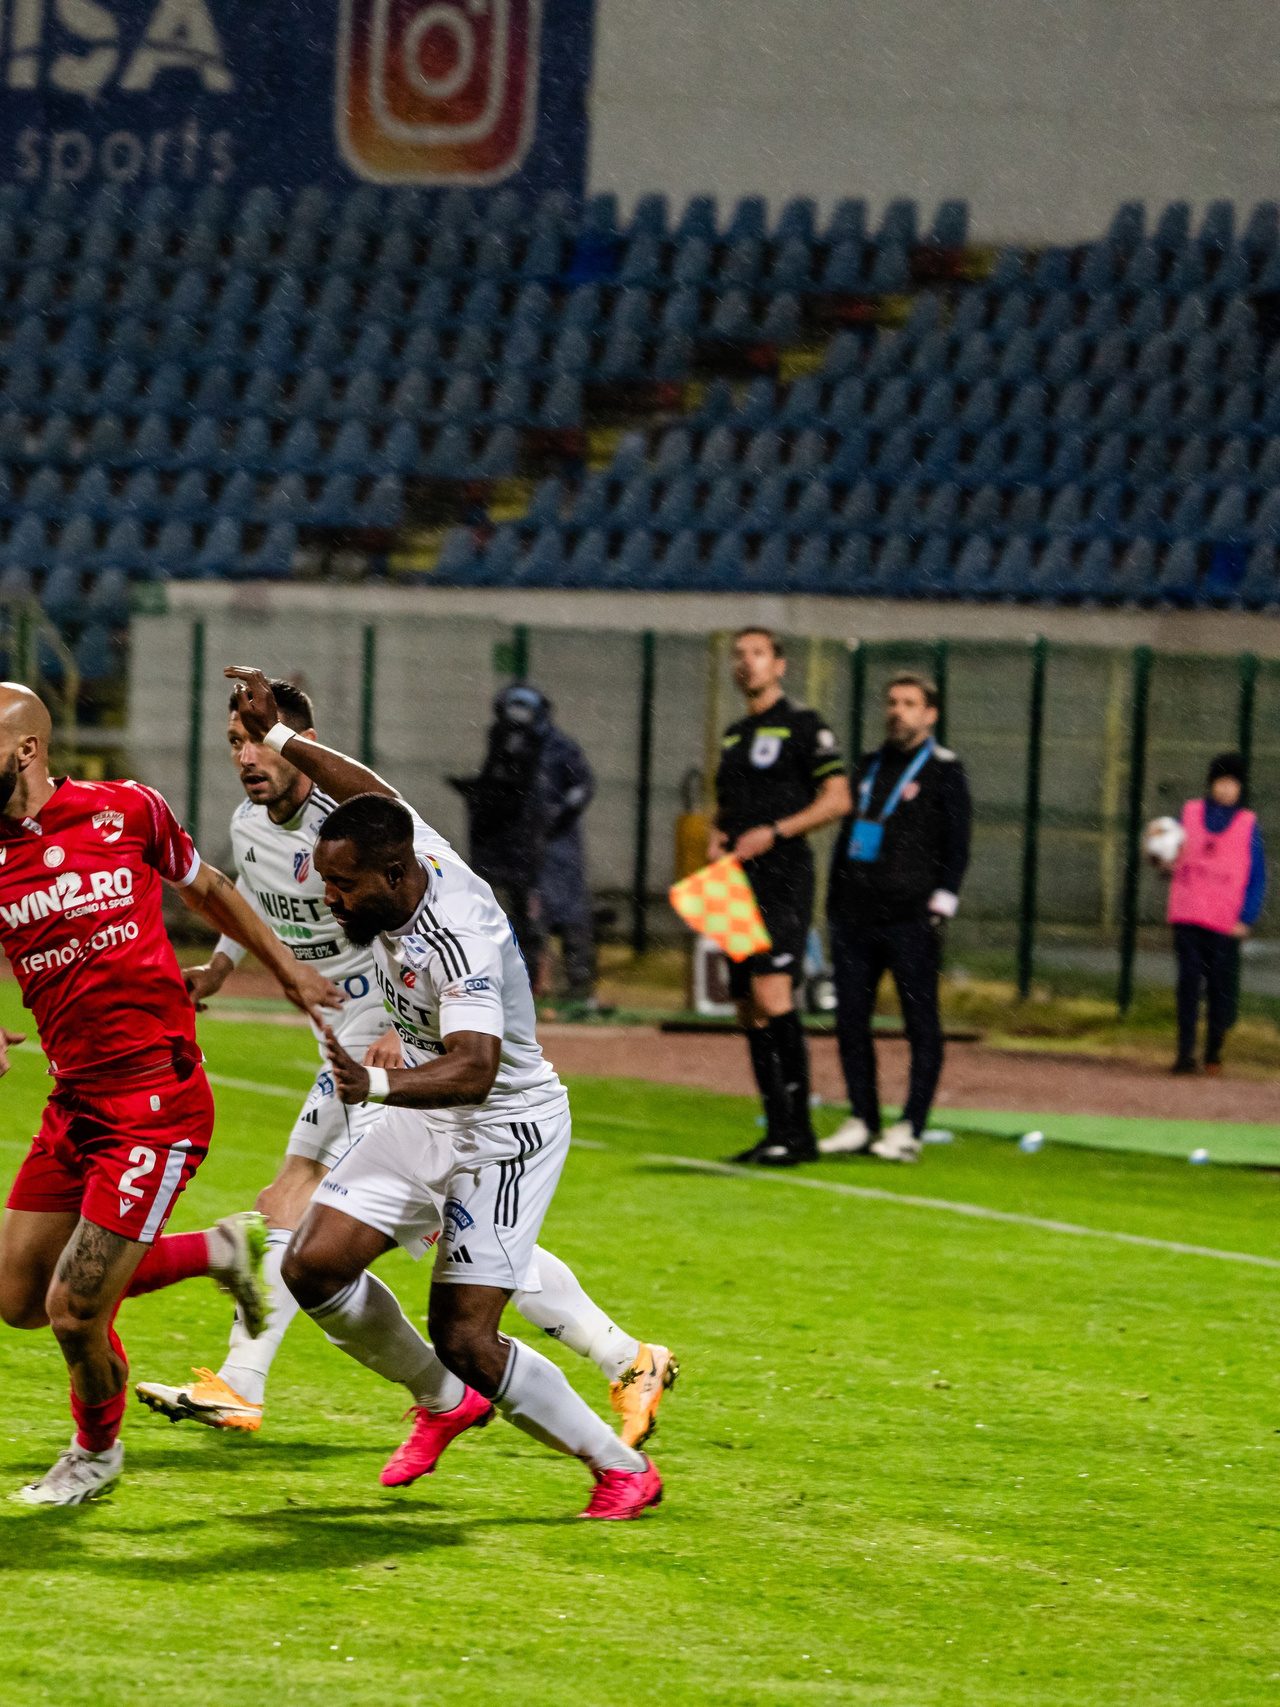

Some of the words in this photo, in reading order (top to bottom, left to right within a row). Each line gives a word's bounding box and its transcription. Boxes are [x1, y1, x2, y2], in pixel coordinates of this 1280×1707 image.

[18, 116, 234, 182] sports
[64, 903, 99, 920] CASINO
[108, 895, 135, 909] SPORT
[118, 1145, 157, 1199] 2
